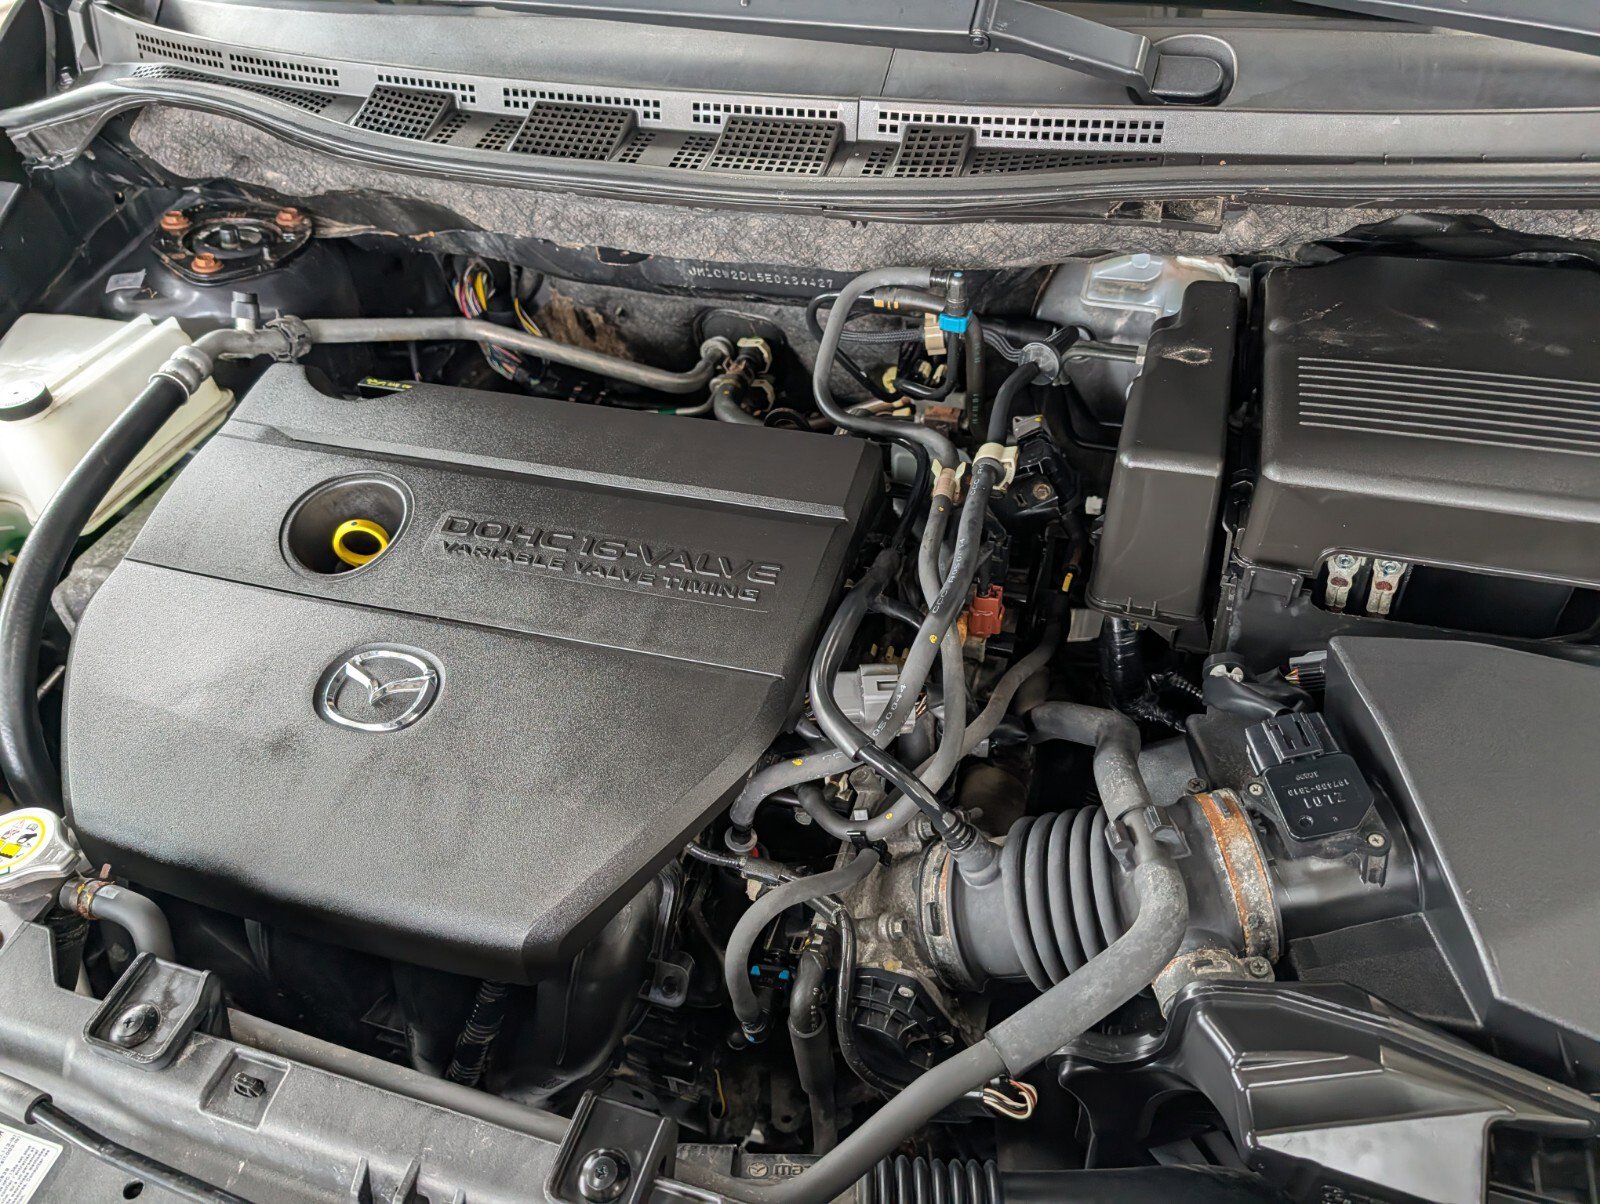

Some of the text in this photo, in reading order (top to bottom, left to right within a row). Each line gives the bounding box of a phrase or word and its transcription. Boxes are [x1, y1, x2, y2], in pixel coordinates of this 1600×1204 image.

[440, 515, 783, 586] DOHC 16-VALVE
[442, 539, 762, 603] VARIABLE VALVE TIMING
